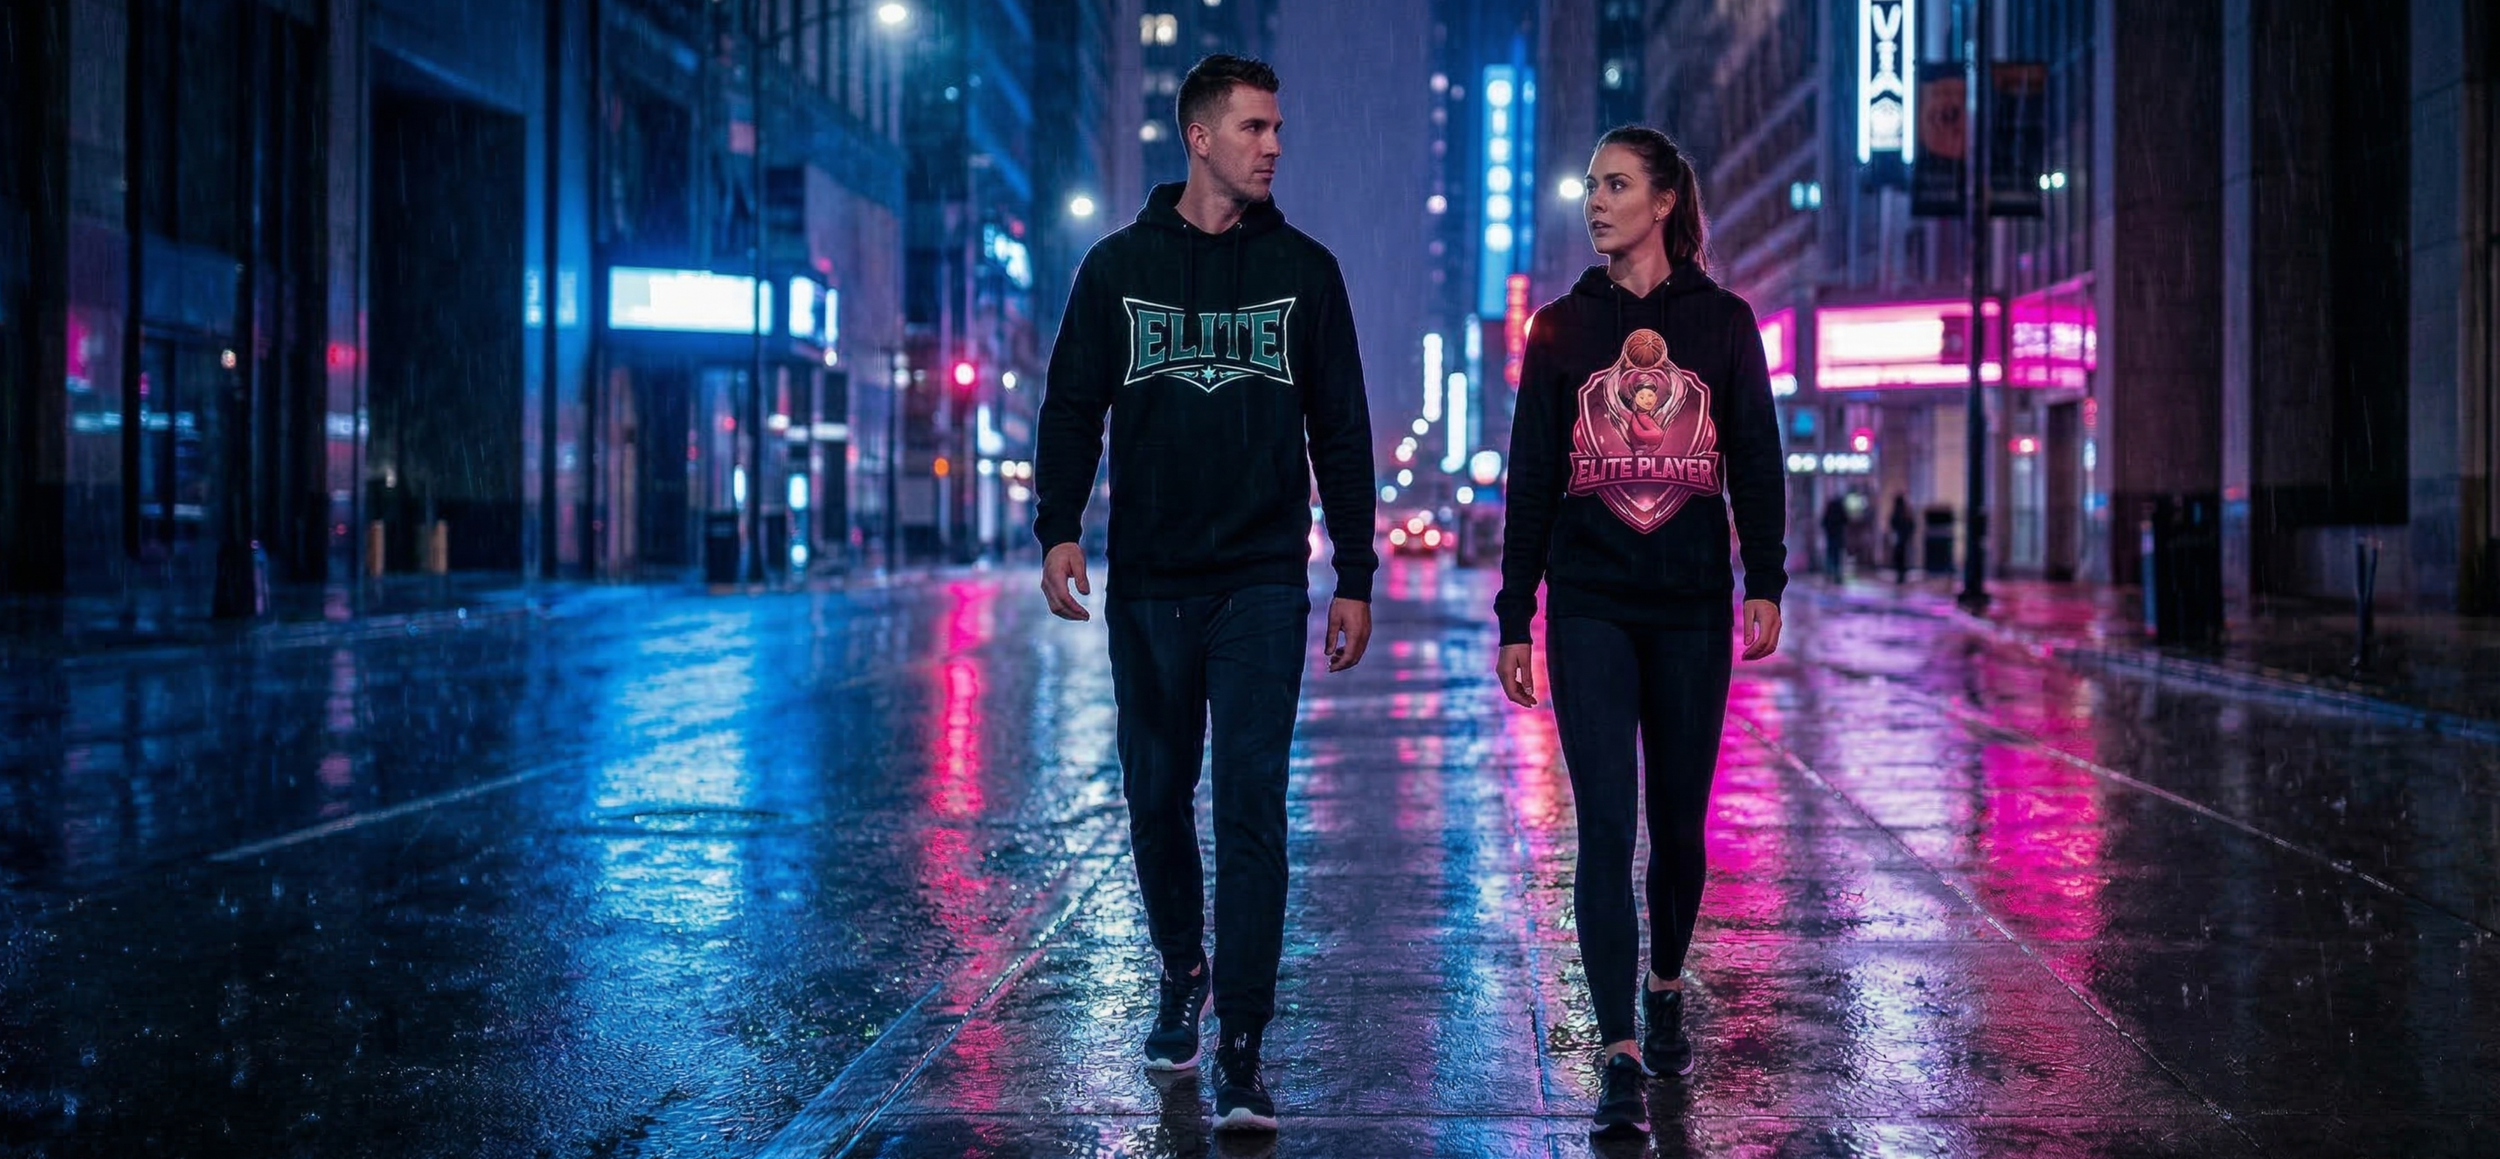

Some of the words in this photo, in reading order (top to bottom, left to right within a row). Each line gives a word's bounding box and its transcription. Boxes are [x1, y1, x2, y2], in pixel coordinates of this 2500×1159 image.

[1136, 309, 1282, 371] ELITE
[1575, 457, 1633, 485] ELITE
[1637, 457, 1714, 486] PLAYER
